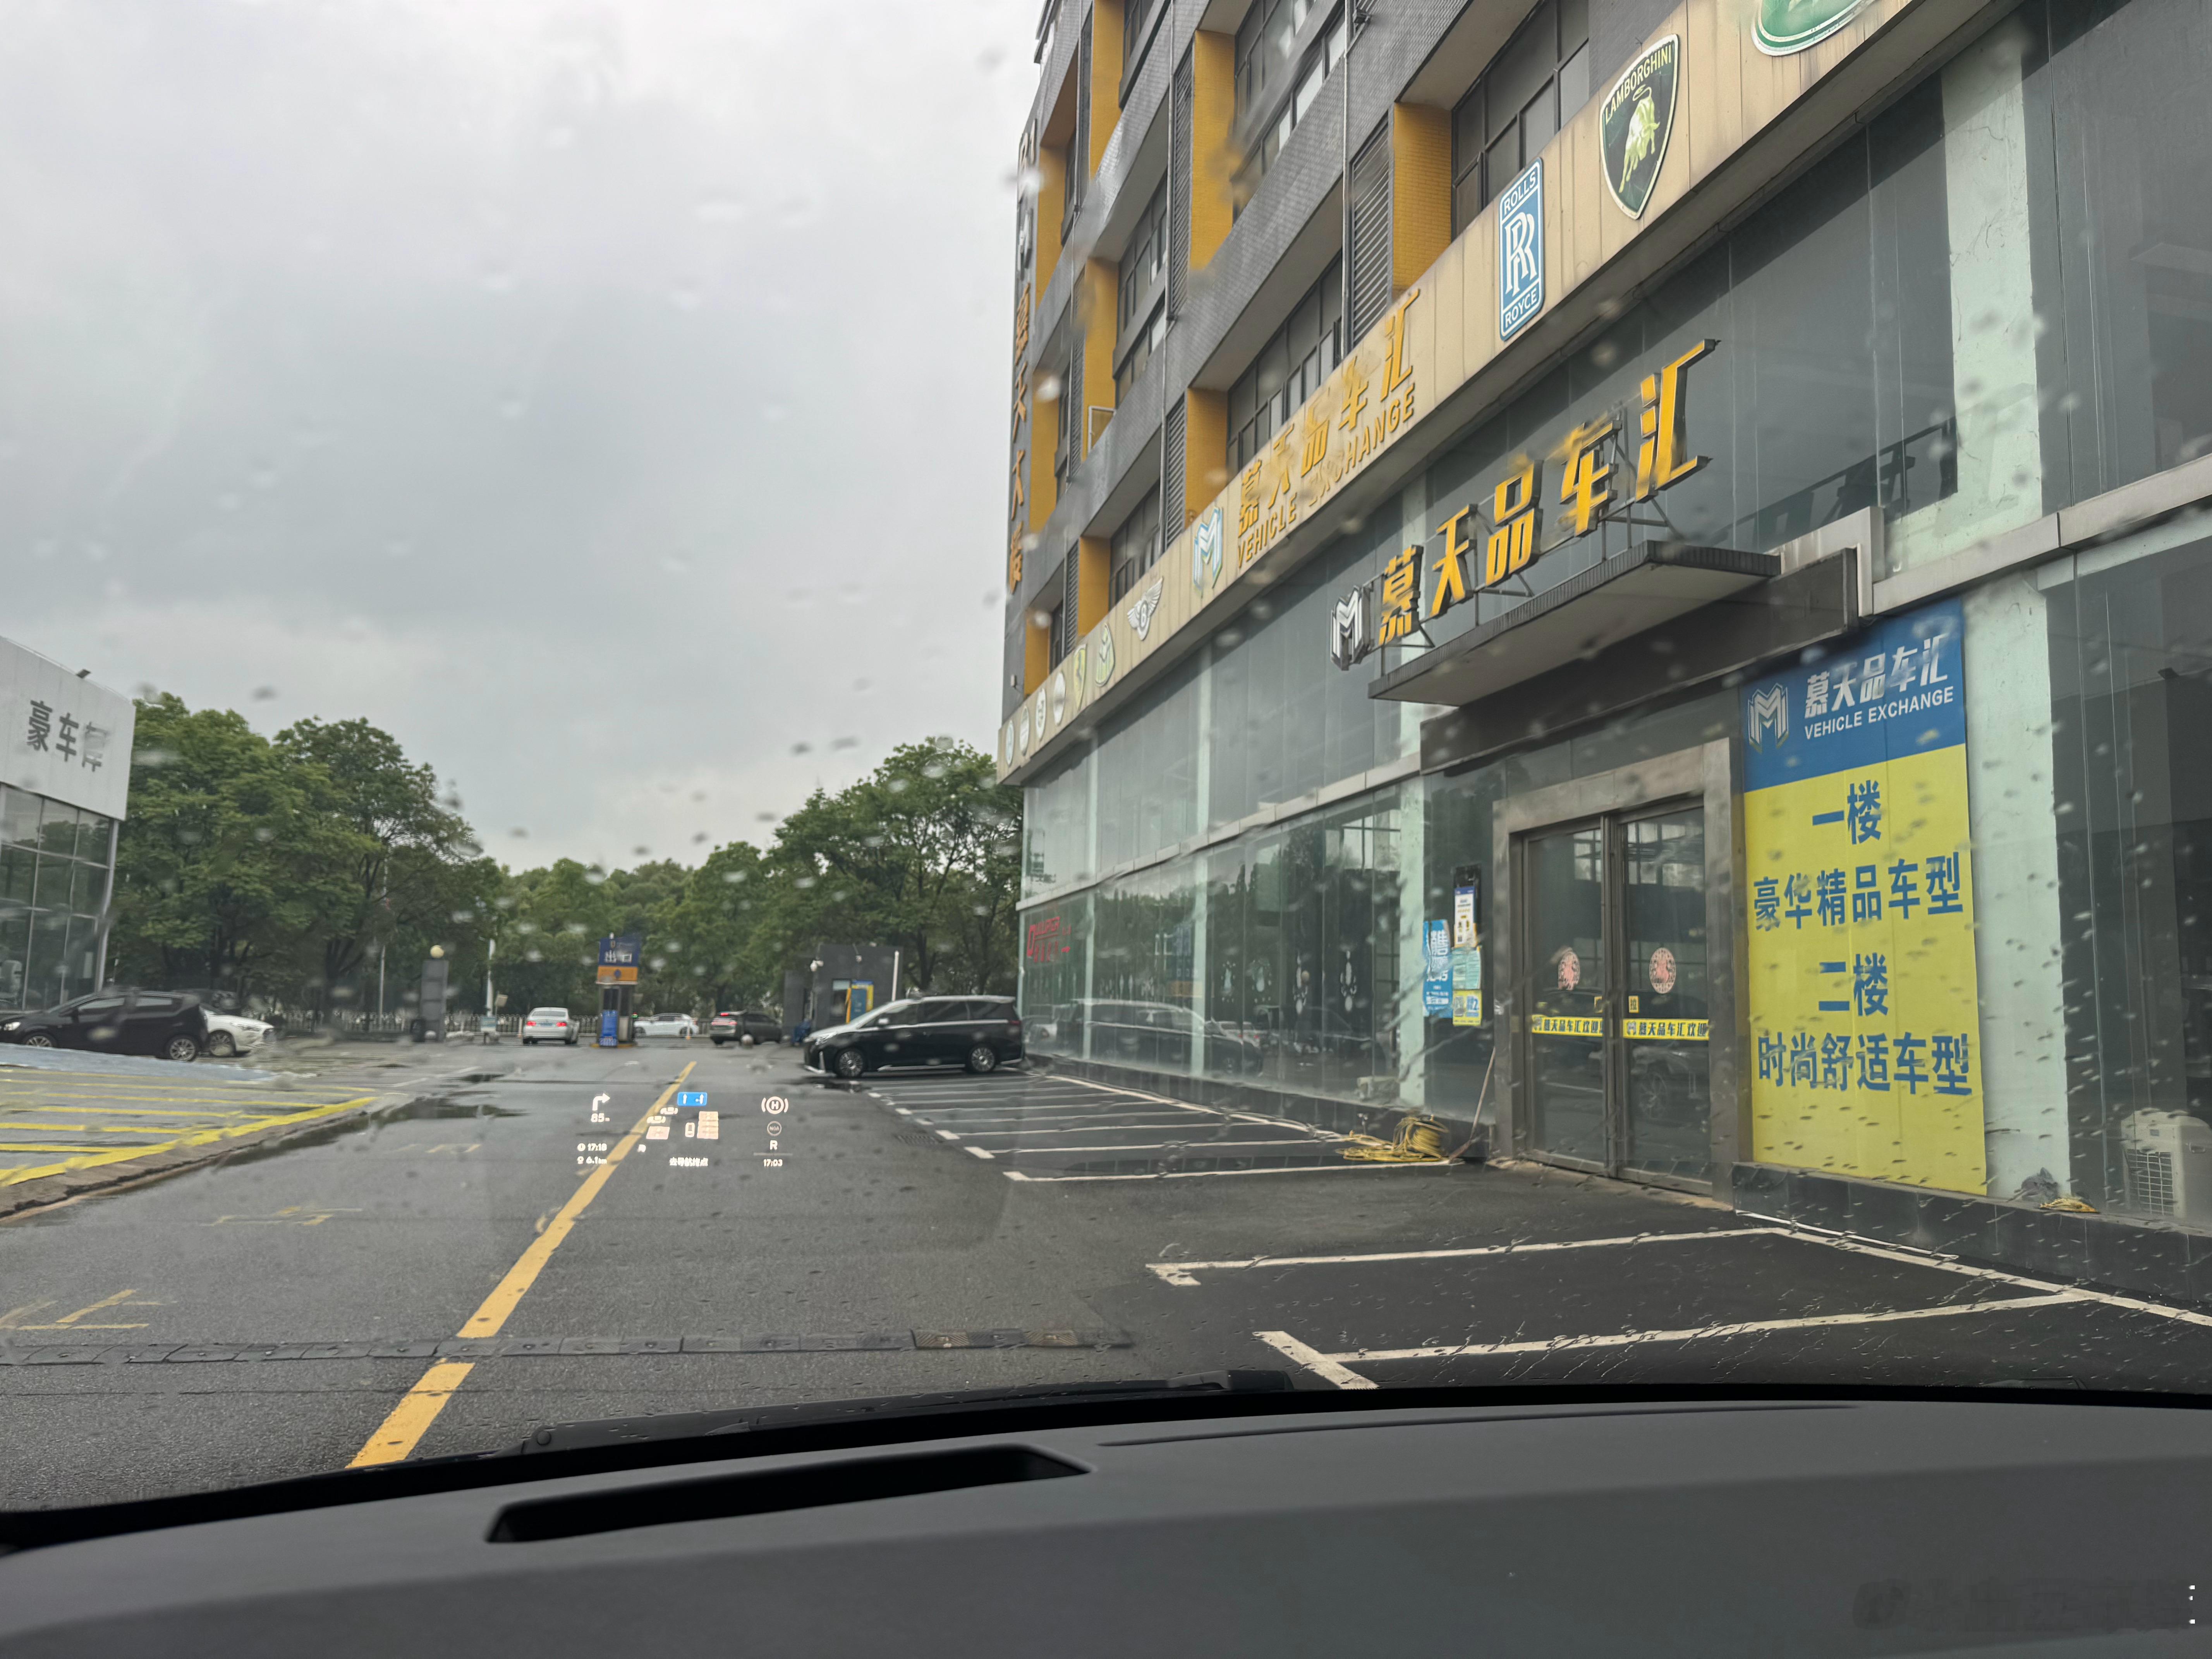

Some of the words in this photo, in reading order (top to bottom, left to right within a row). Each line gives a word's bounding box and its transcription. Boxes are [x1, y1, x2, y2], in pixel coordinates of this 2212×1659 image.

[1605, 45, 1671, 125] LAMBORGHINI
[1504, 171, 1536, 215] ROLLS
[1505, 288, 1537, 328] ROYCE
[1238, 288, 1420, 538] 慕天品车汇
[1377, 339, 1716, 646] 慕天品车汇
[1238, 492, 1297, 568] VEHICLE
[1805, 633, 1949, 719] 慕天品车汇
[1805, 711, 1862, 740] VEHICLE
[1868, 685, 1954, 723] EXCHANGE
[1812, 780, 1882, 845] 一楼
[1753, 852, 1963, 932] 豪华精品车型
[605, 950, 632, 963] 出口
[1818, 952, 1889, 1017] 二楼
[1758, 1032, 1972, 1096] 时尚舒适车型
[763, 1159, 783, 1167] 17:03
[769, 1140, 778, 1150] R
